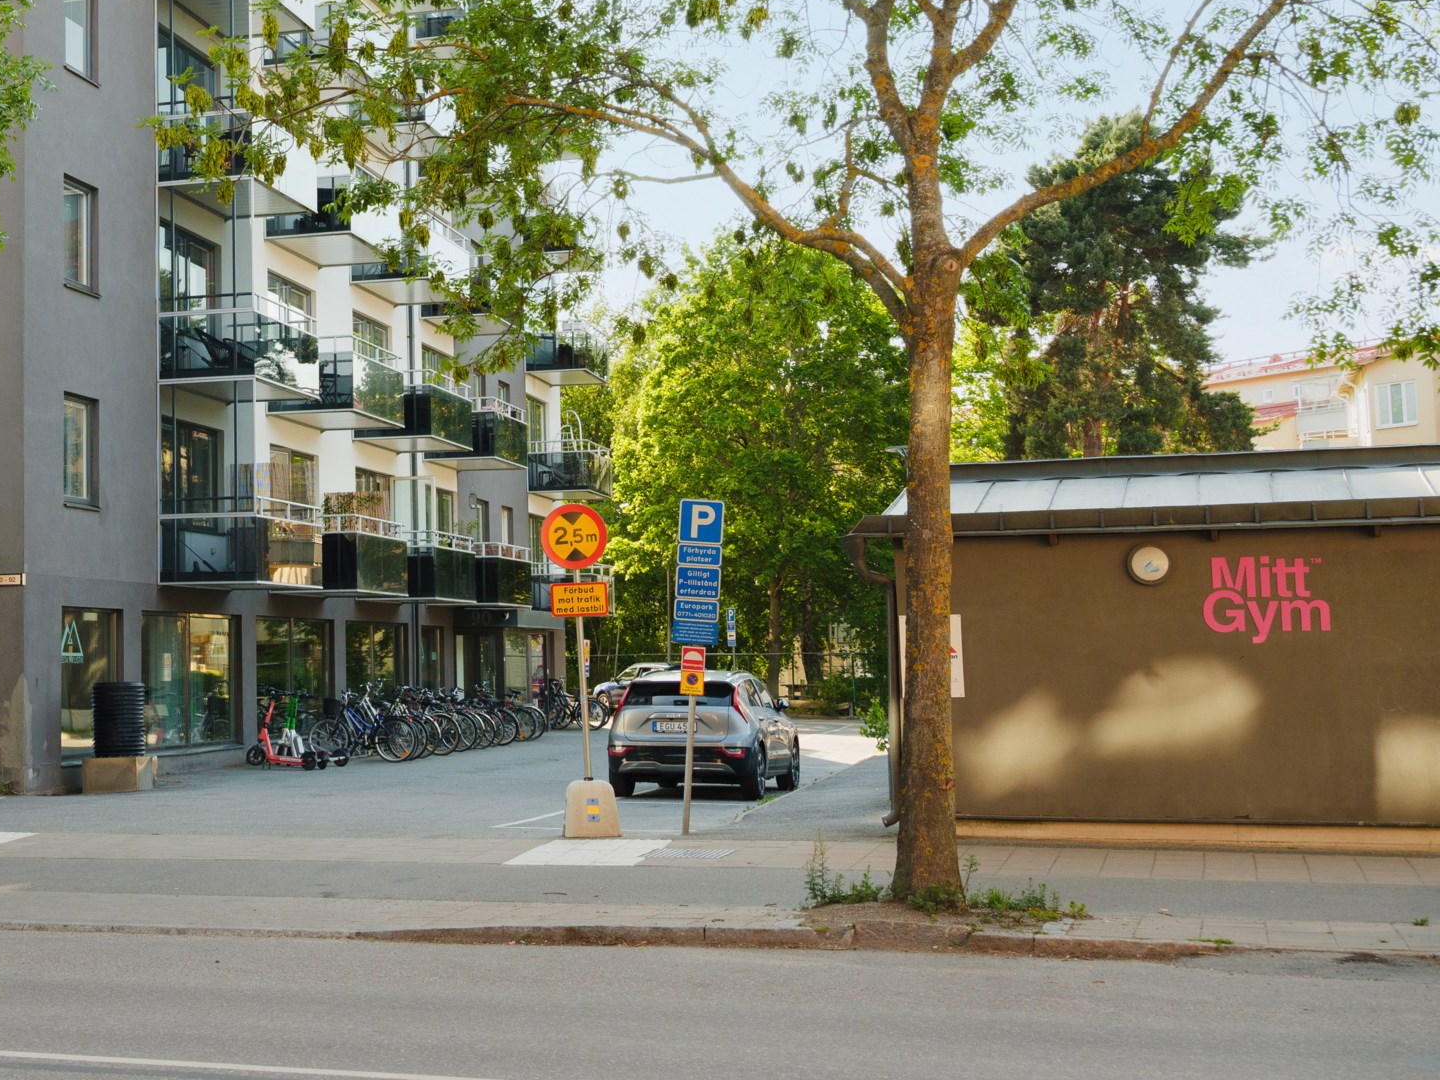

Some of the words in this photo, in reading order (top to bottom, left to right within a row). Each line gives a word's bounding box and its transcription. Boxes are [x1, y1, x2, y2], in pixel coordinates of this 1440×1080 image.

[690, 504, 716, 538] P
[683, 546, 716, 555] Förhyrda
[686, 555, 712, 563] platser
[687, 570, 710, 579] Giltigt
[1211, 555, 1311, 598] Mitt
[679, 578, 718, 587] P-tillstånd
[563, 586, 594, 594] Förbud
[680, 587, 716, 596] erfordras
[577, 595, 601, 603] trafik
[556, 606, 574, 614] med
[577, 605, 604, 613] lastbil
[680, 602, 713, 611] Europark
[677, 611, 716, 619] 0771-401020
[728, 609, 734, 621] P
[1202, 589, 1331, 644] Gym
